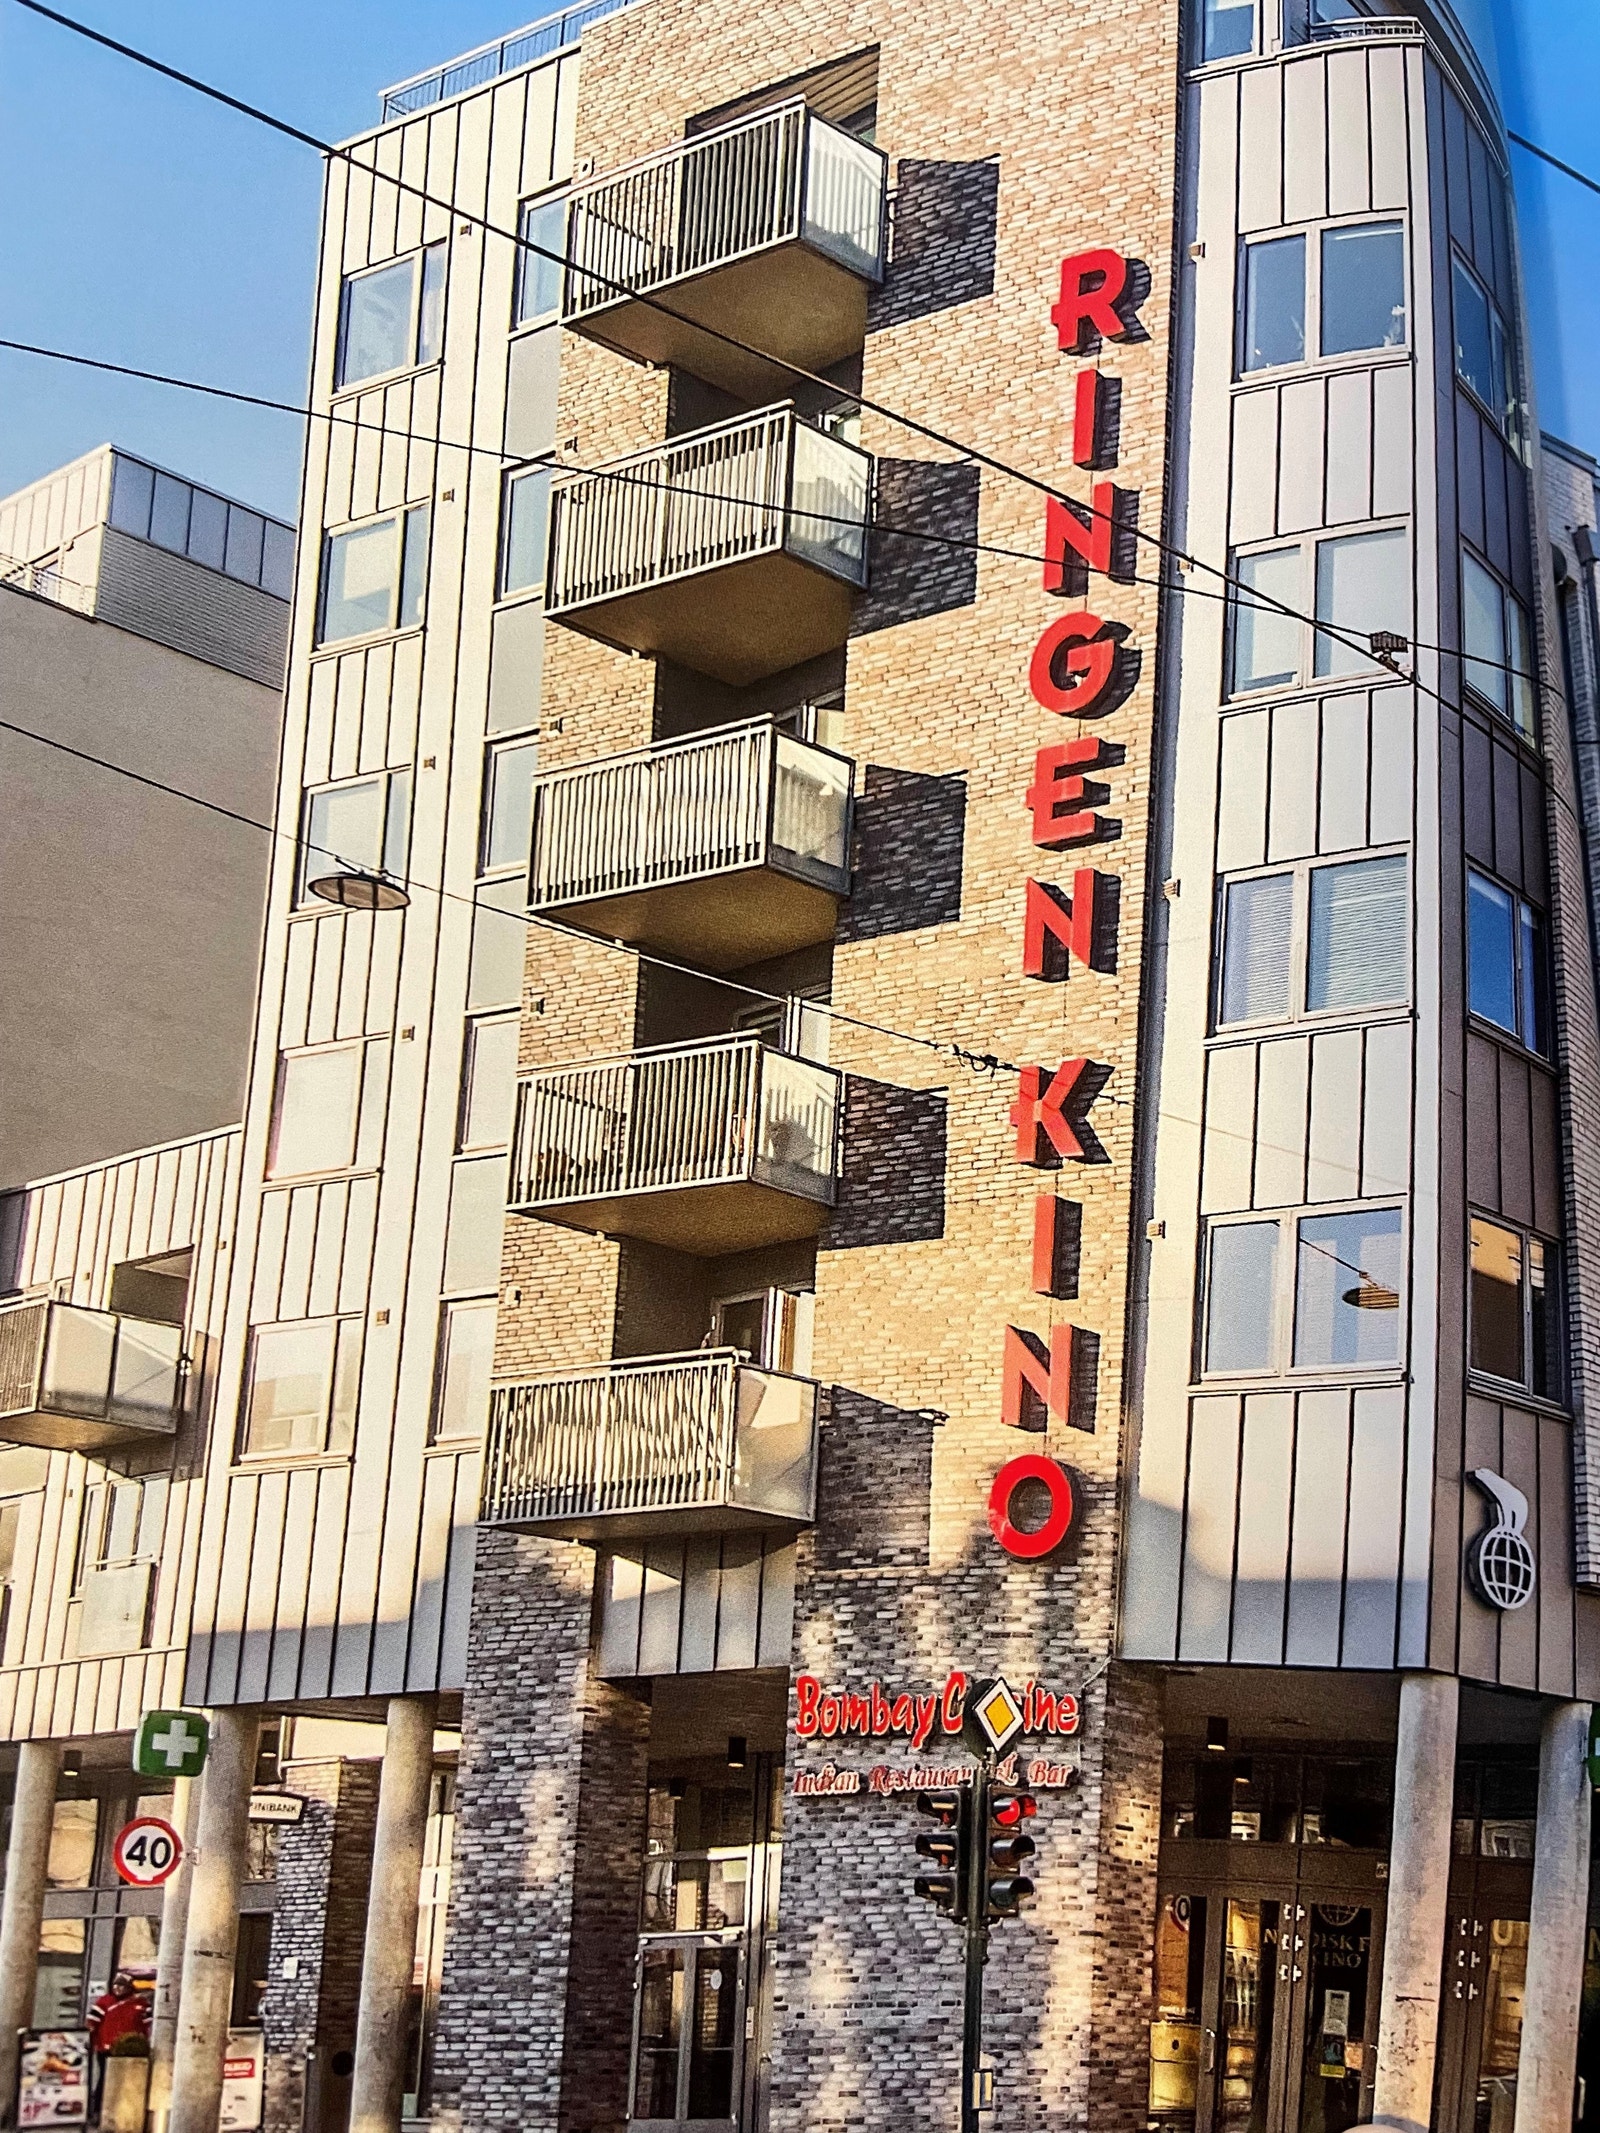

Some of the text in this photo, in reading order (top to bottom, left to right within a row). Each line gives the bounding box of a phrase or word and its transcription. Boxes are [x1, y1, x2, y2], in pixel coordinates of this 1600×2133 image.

[988, 248, 1127, 1559] RINGEN KINO
[796, 1672, 1080, 1750] Bombay Cine
[792, 1761, 861, 1797] Indian
[868, 1764, 976, 1794] Restauran
[1028, 1758, 1074, 1788] Bar
[252, 1802, 298, 1813] INIBANK
[126, 1835, 171, 1868] 40
